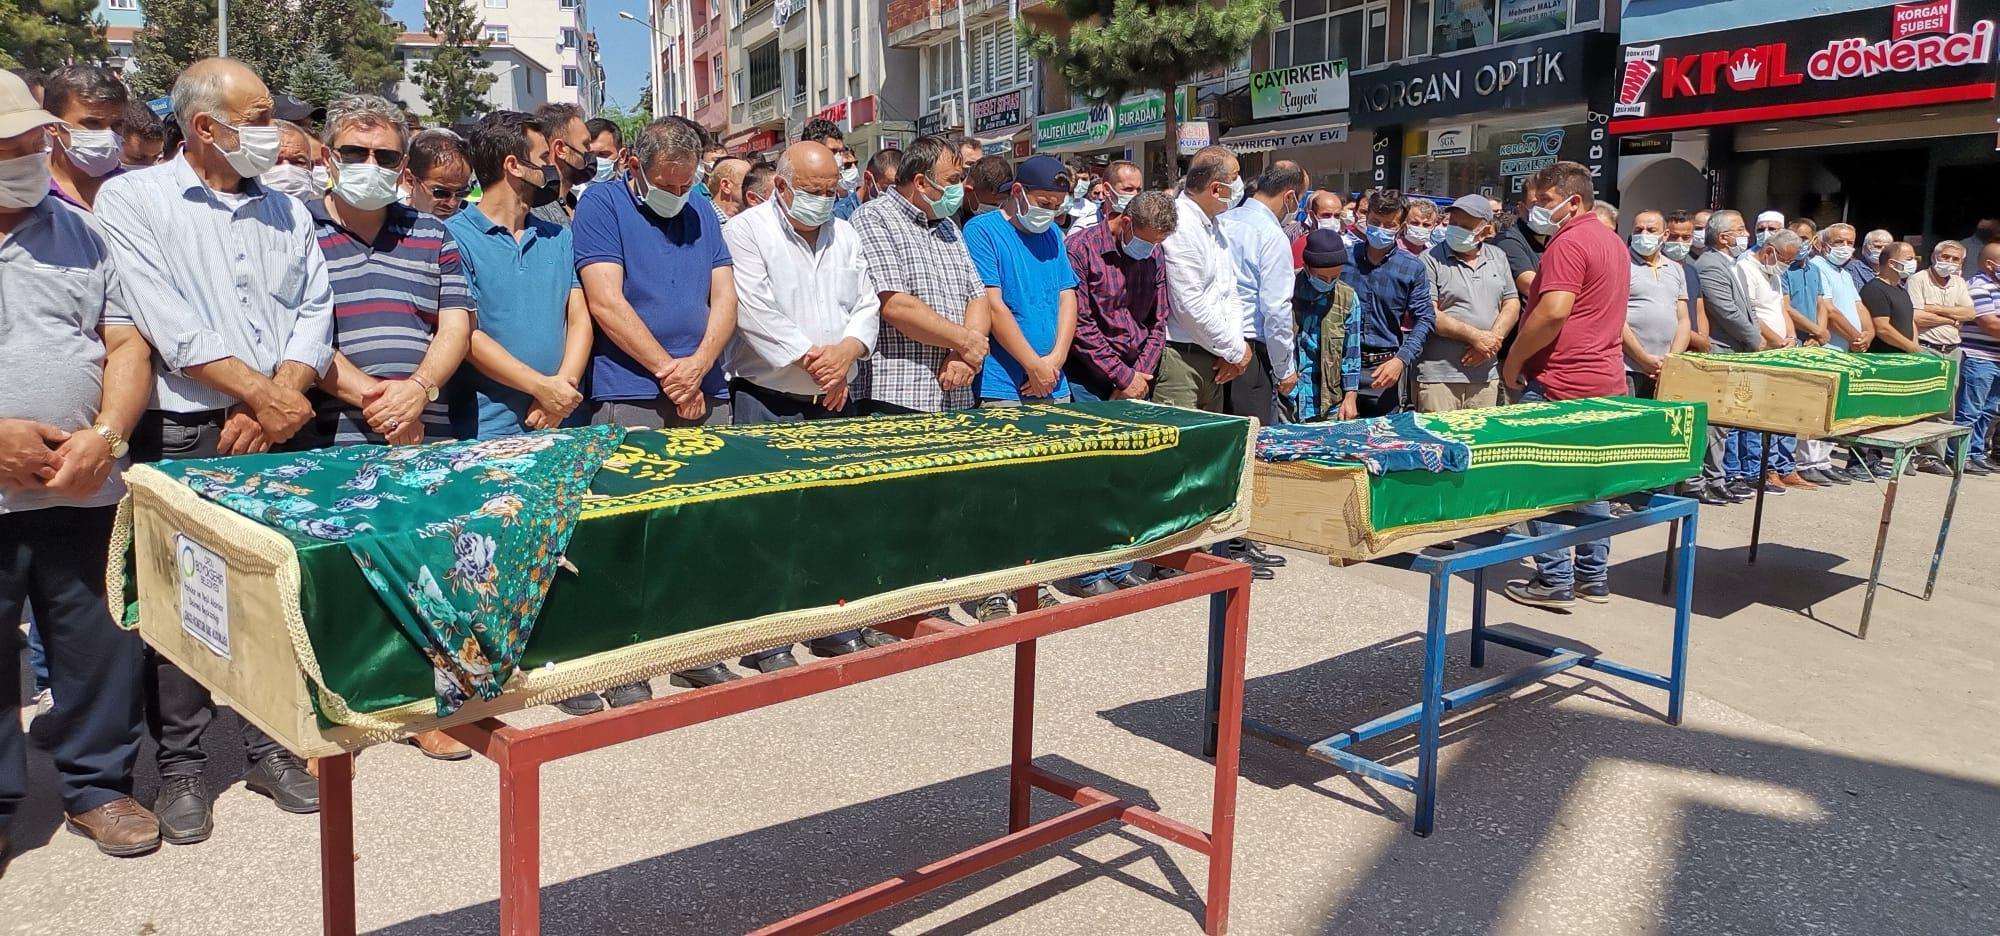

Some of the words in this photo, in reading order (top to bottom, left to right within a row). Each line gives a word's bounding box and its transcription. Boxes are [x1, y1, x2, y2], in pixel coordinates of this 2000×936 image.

[1896, 4, 1949, 22] KORGAN
[1899, 15, 1944, 36] ŞUBESİ
[1253, 61, 1343, 92] ÇAYIRKENT
[1354, 69, 1462, 114] KORGAN
[1474, 47, 1566, 97] OPTİK
[1283, 87, 1318, 113] Çayevi
[1089, 104, 1108, 123] 1001
[1119, 106, 1157, 126] BURADAN
[1038, 118, 1066, 142] KALİTEYİ
[1292, 133, 1315, 147] ÇAY
[1439, 135, 1456, 147] SGK
[1499, 141, 1537, 156] KORGAN
